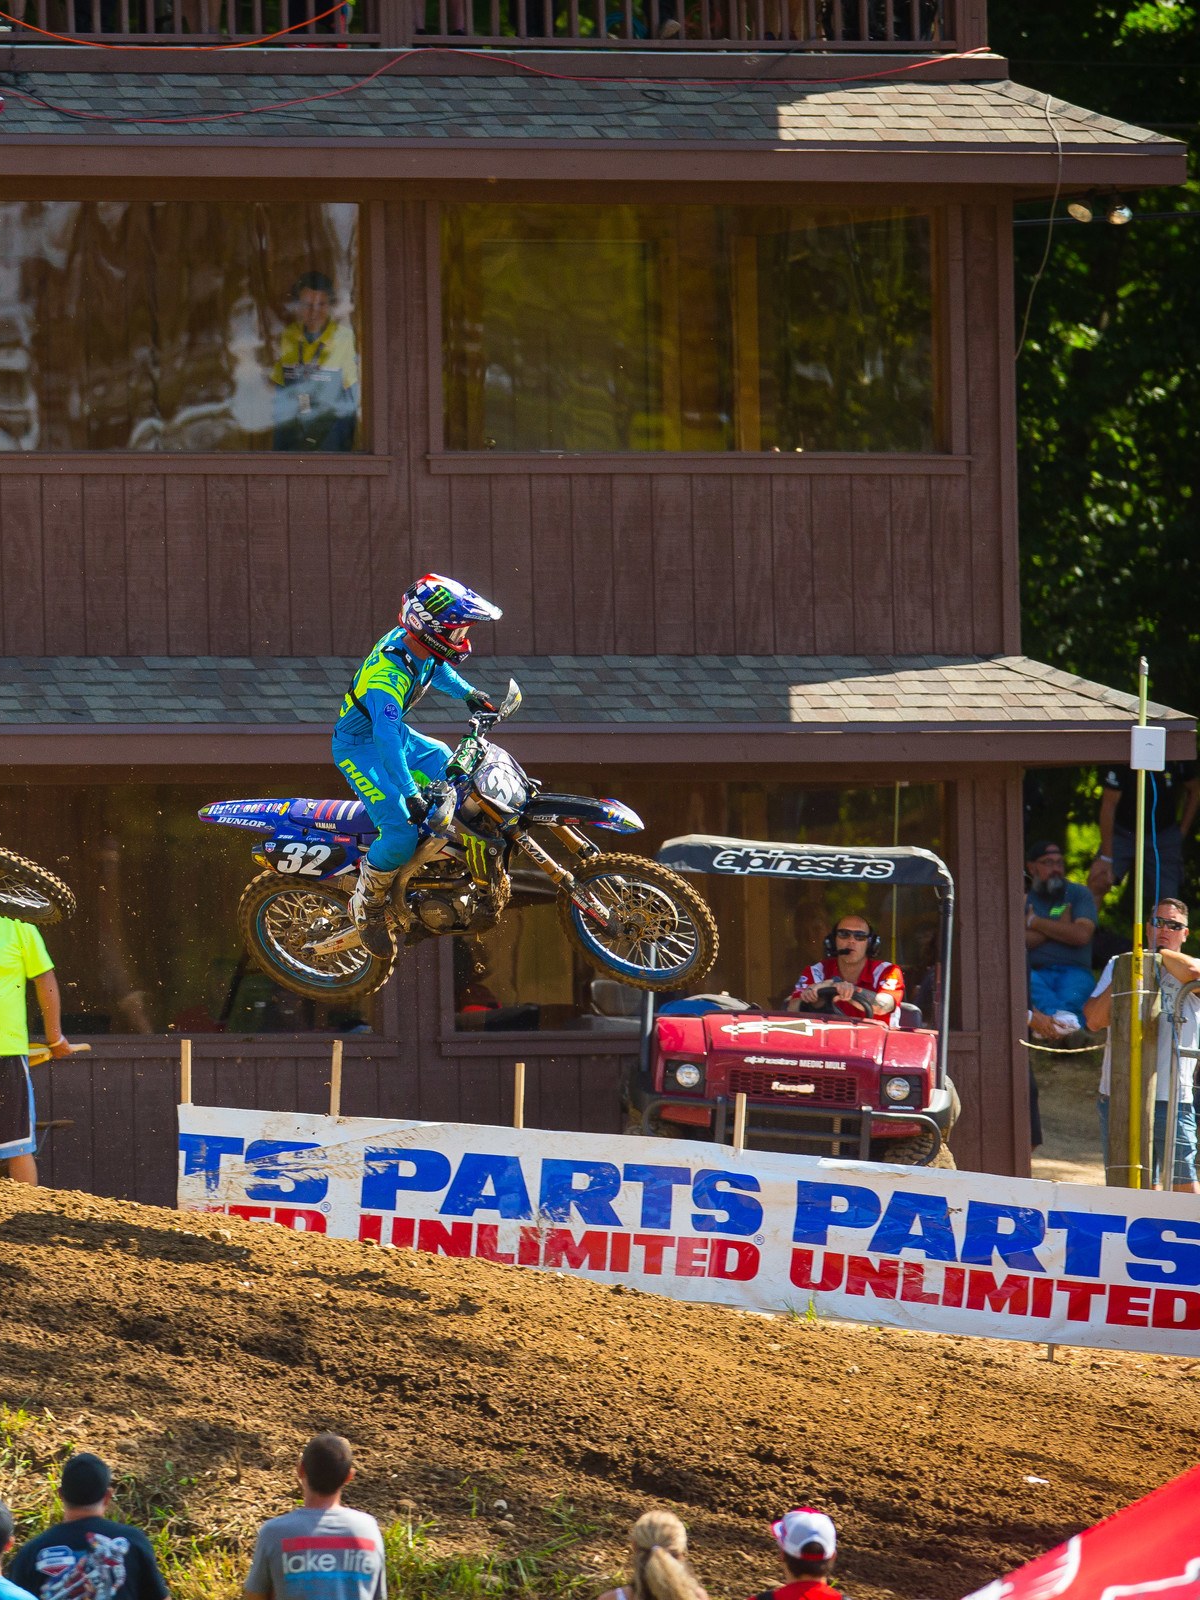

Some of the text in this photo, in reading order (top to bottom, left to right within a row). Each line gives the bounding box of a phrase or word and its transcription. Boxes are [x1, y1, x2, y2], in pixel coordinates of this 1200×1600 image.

[424, 633, 448, 652] MONSTER
[339, 758, 386, 805] THOR
[217, 817, 266, 828] DUNLOP
[315, 822, 337, 830] YAMAHA
[277, 842, 331, 876] 32
[515, 834, 547, 864] KYB
[713, 848, 895, 879] alpinestars
[799, 1059, 824, 1069] MEDIC
[825, 1061, 847, 1070] MULE
[360, 1146, 764, 1236] PARTS
[358, 1214, 761, 1281] UNLIMITED
[793, 1180, 1200, 1286] PARTS
[789, 1247, 1200, 1331] UNLIMITED
[282, 1549, 375, 1575] lake life
